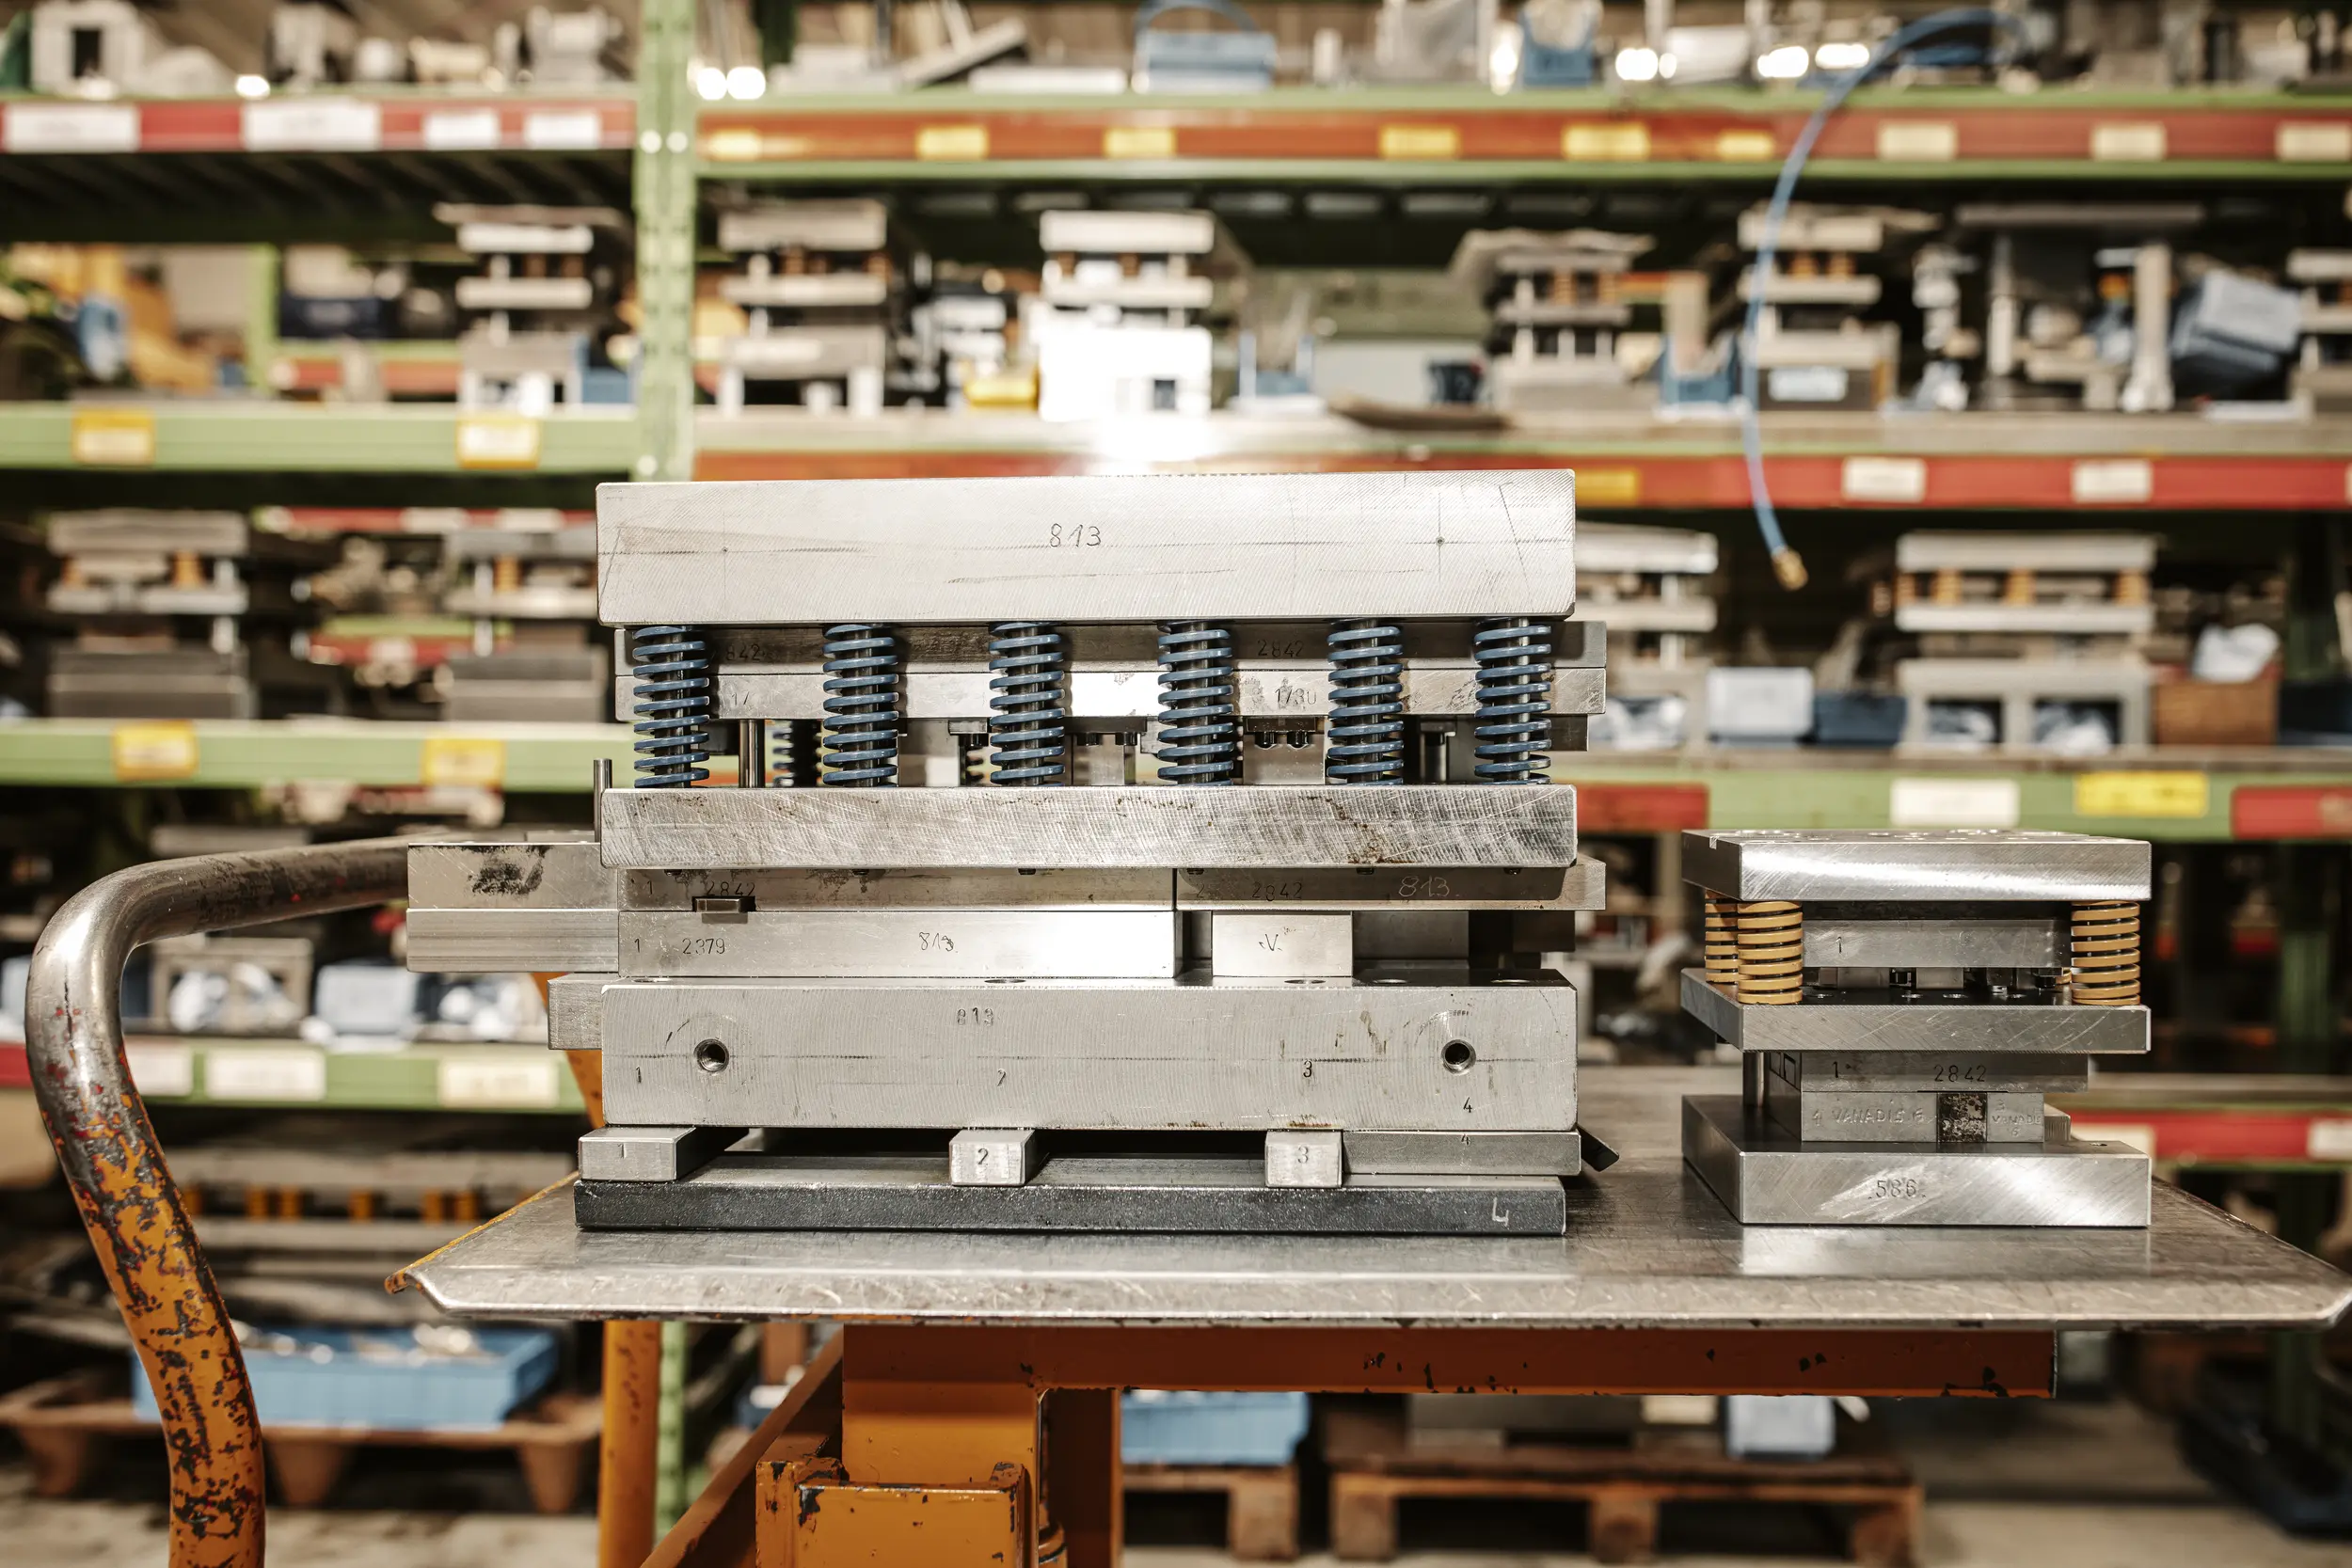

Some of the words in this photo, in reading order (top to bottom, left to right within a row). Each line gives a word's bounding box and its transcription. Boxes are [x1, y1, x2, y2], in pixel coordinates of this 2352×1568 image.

[1049, 522, 1102, 547] 813
[1257, 640, 1305, 658] 2842
[706, 881, 755, 898] 2842
[1251, 881, 1302, 902] 2842
[633, 938, 641, 953] 1
[681, 938, 726, 955] 2379
[635, 1066, 642, 1084] 1
[1303, 1060, 1312, 1078] 3
[1933, 1064, 1987, 1083] 2842
[1462, 1096, 1472, 1114] 4
[617, 1143, 626, 1159] 1
[977, 1148, 989, 1165] 2
[1297, 1146, 1309, 1164] 3
[1491, 1196, 1510, 1227] 4
